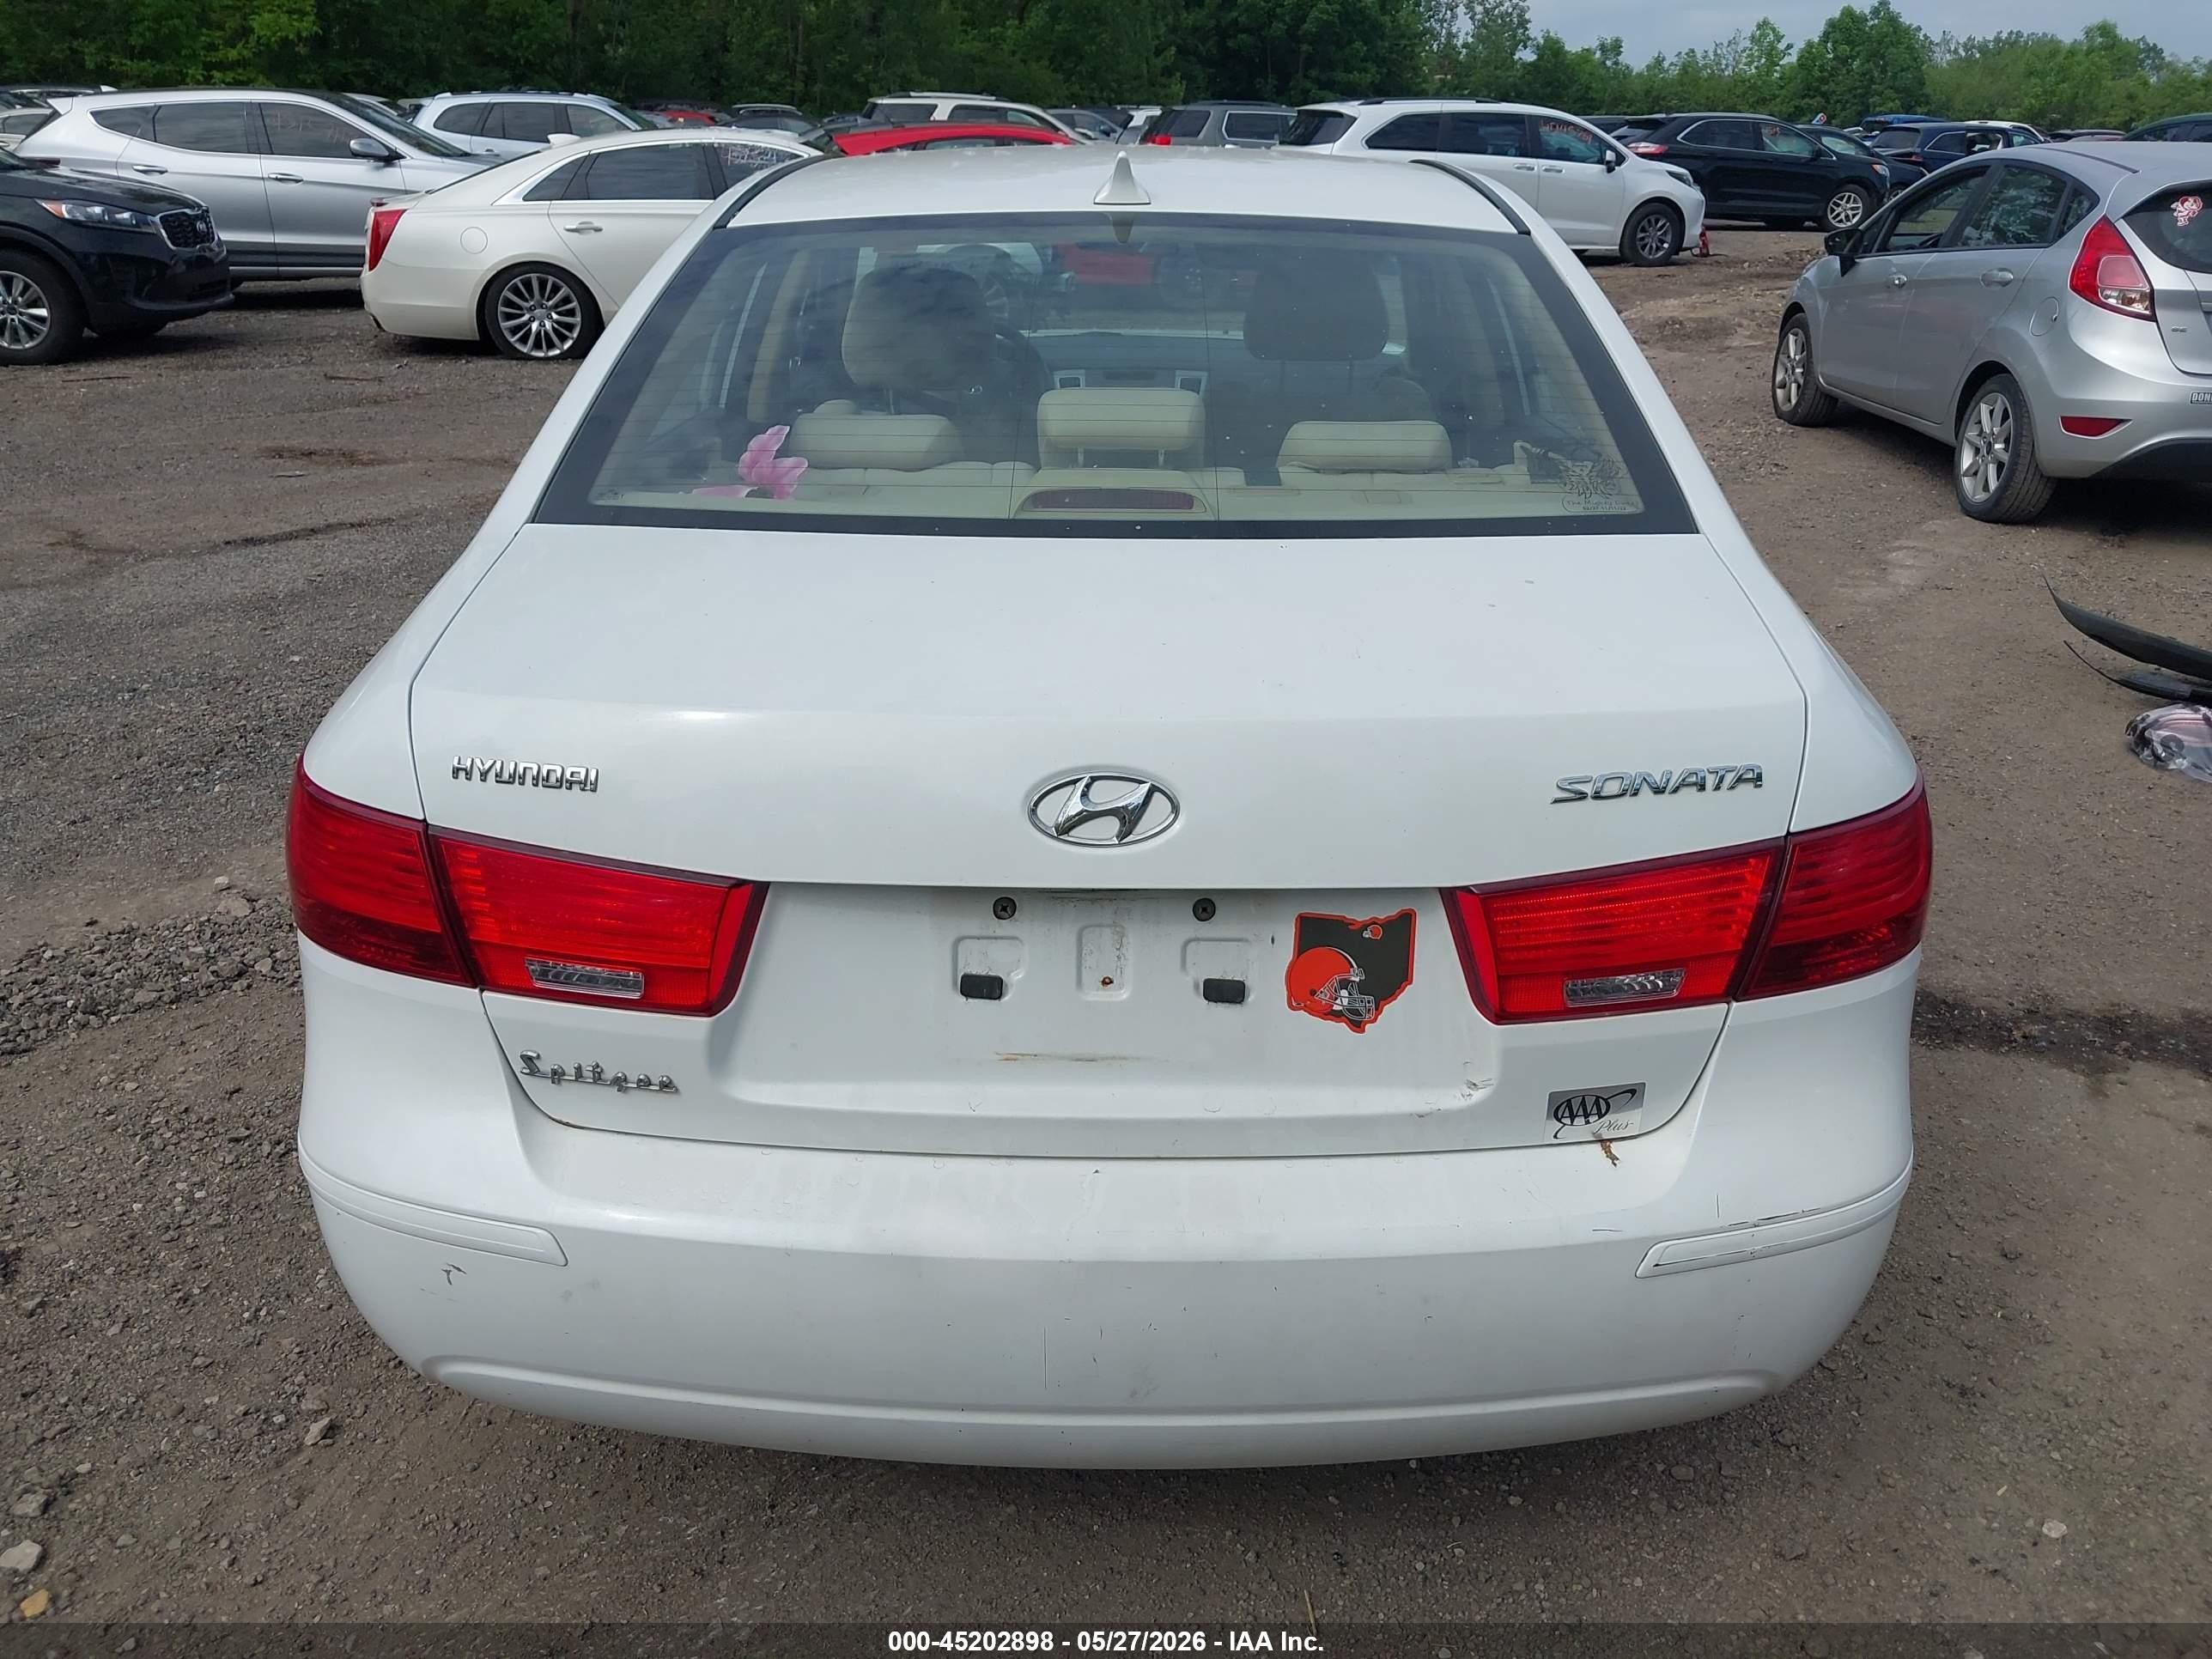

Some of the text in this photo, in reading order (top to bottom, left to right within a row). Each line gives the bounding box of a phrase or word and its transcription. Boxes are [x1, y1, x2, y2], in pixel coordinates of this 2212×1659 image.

[2191, 392, 2212, 402] DON
[452, 755, 599, 793] HYUNDAI
[1549, 763, 1763, 805] SONATA
[1556, 1094, 1607, 1126] AAA
[1594, 1119, 1633, 1134] Plus
